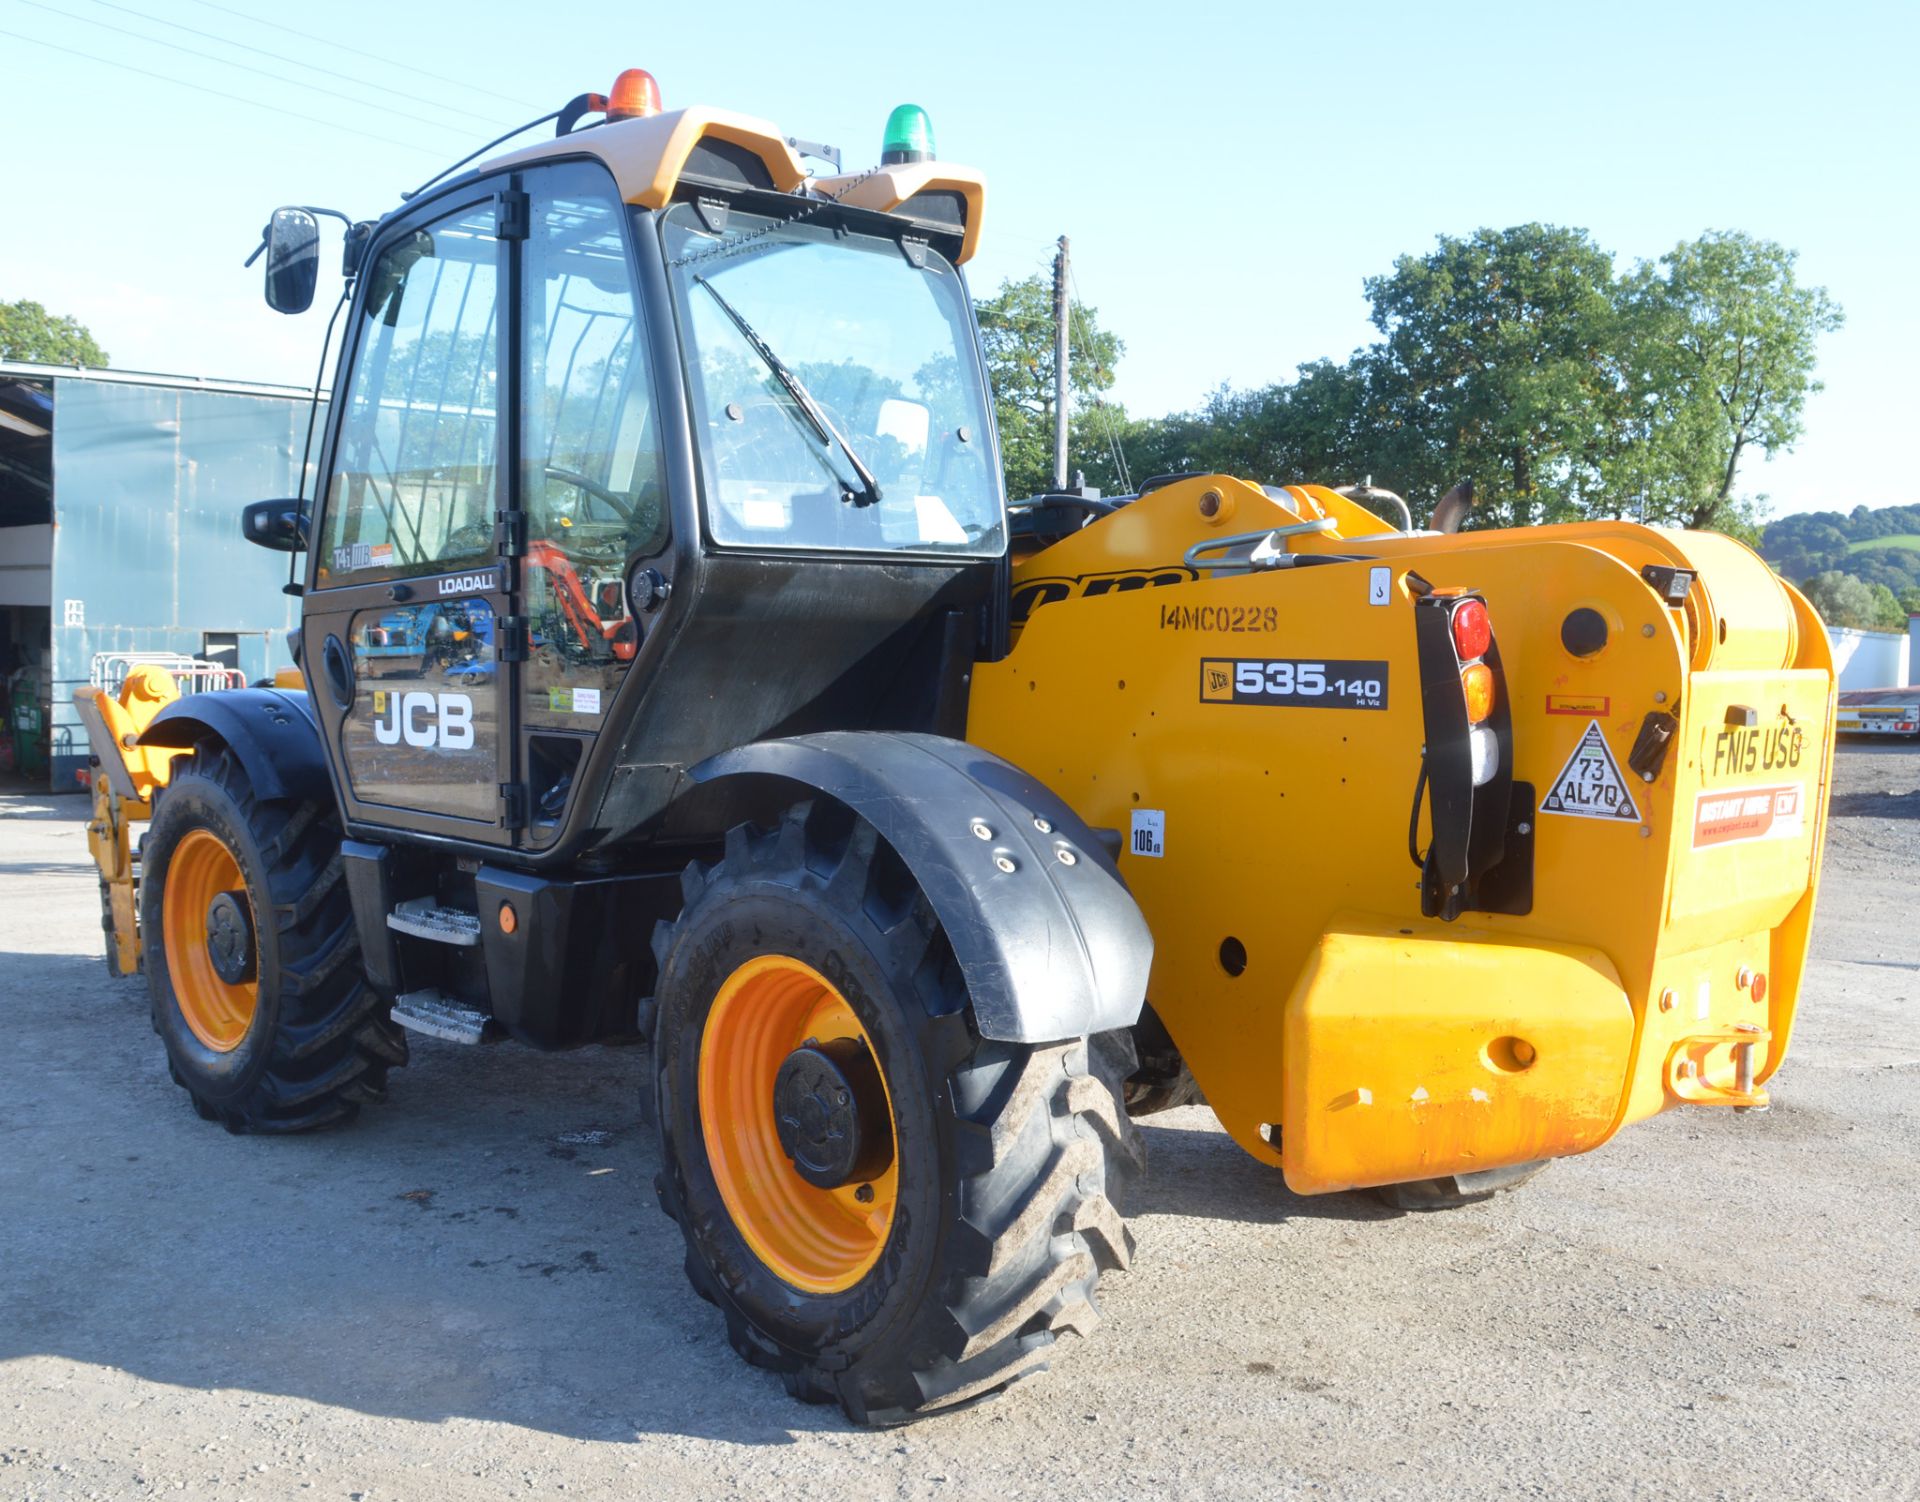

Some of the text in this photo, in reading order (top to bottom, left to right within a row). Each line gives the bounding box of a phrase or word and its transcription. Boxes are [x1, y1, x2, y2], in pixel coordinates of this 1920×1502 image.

[439, 574, 495, 594] LOADALL
[1208, 671, 1230, 690] JCB
[375, 691, 475, 750] JCB
[1579, 758, 1605, 781] 73
[1564, 781, 1618, 807] AL7Q
[1134, 829, 1153, 852] 106
